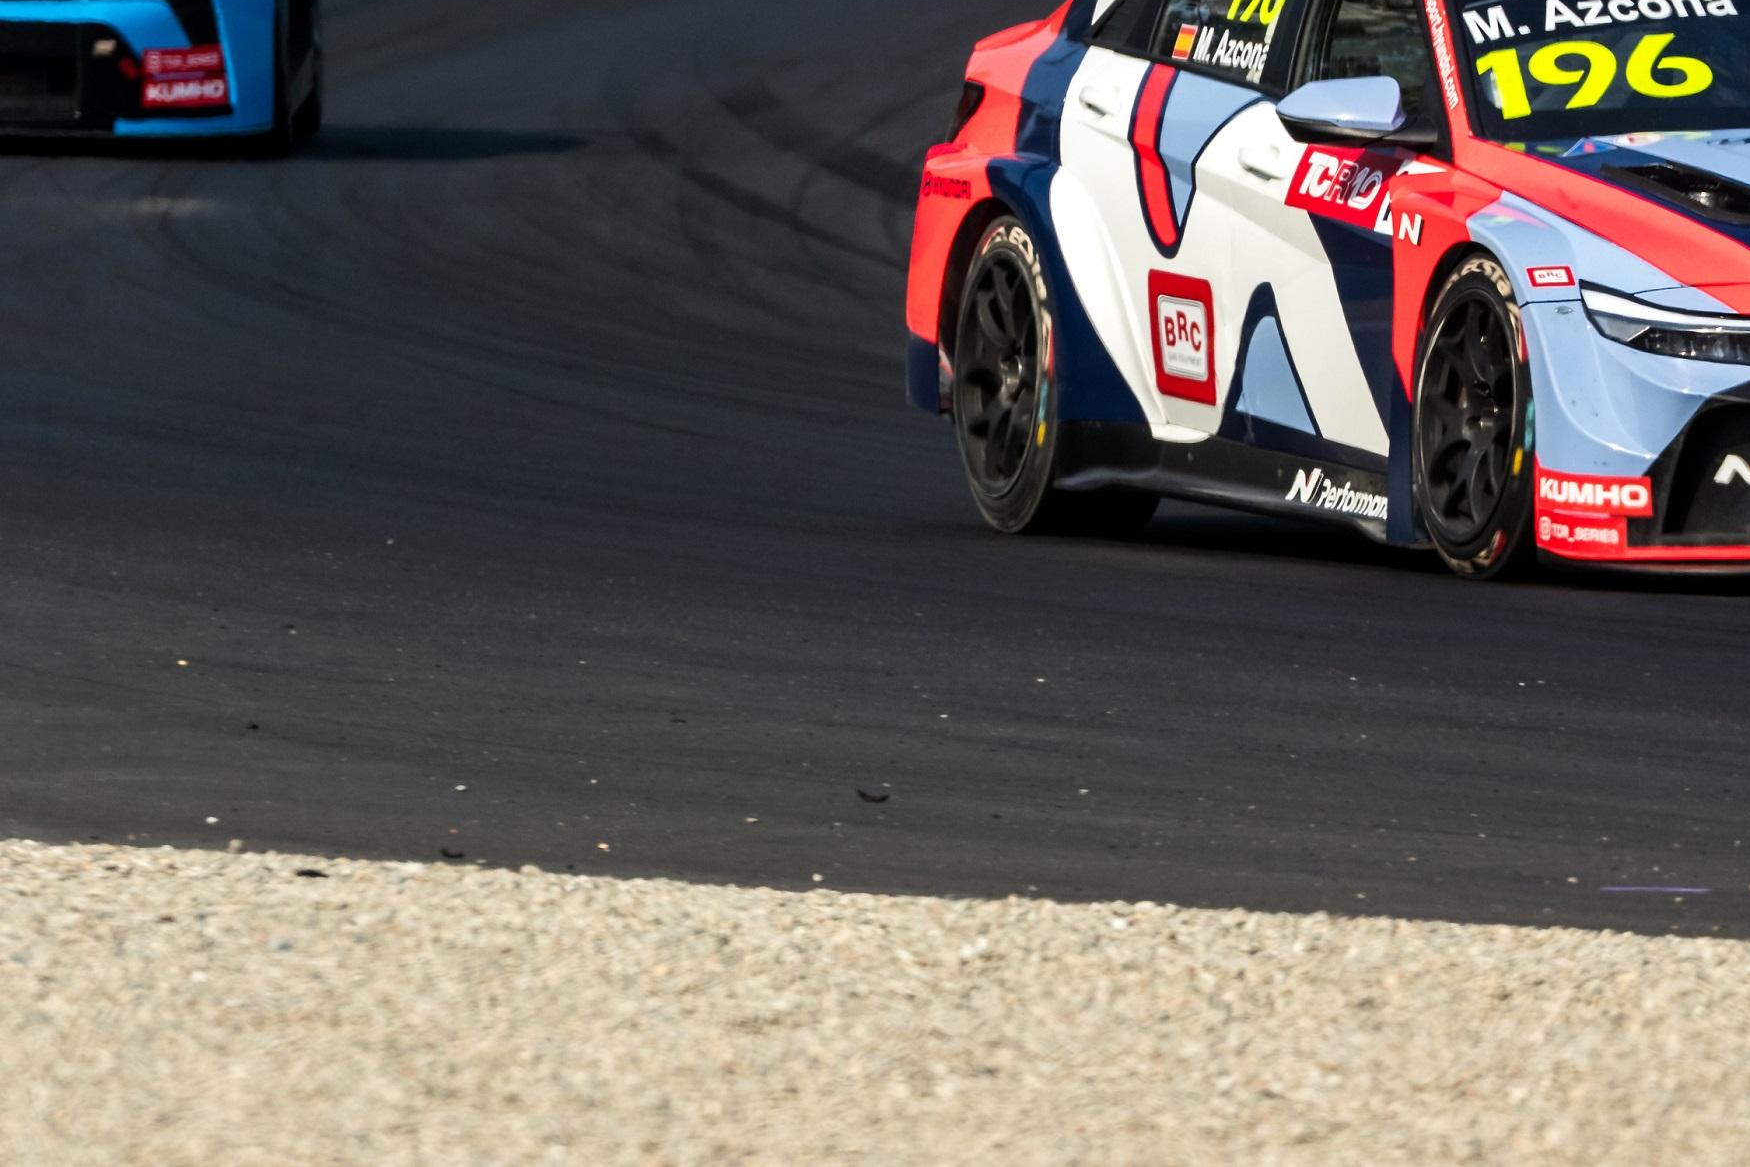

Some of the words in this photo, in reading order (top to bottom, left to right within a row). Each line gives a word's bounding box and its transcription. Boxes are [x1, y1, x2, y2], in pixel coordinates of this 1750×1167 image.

[1462, 5, 1531, 45] M.
[1193, 25, 1211, 64] M.
[146, 80, 225, 102] KUMHO
[1476, 32, 1714, 121] 196
[1398, 211, 1425, 246] N
[1163, 309, 1203, 352] BRC
[1285, 467, 1325, 504] N
[1540, 477, 1649, 510] KUMHO
[1551, 522, 1619, 545] TCR_SERIES
